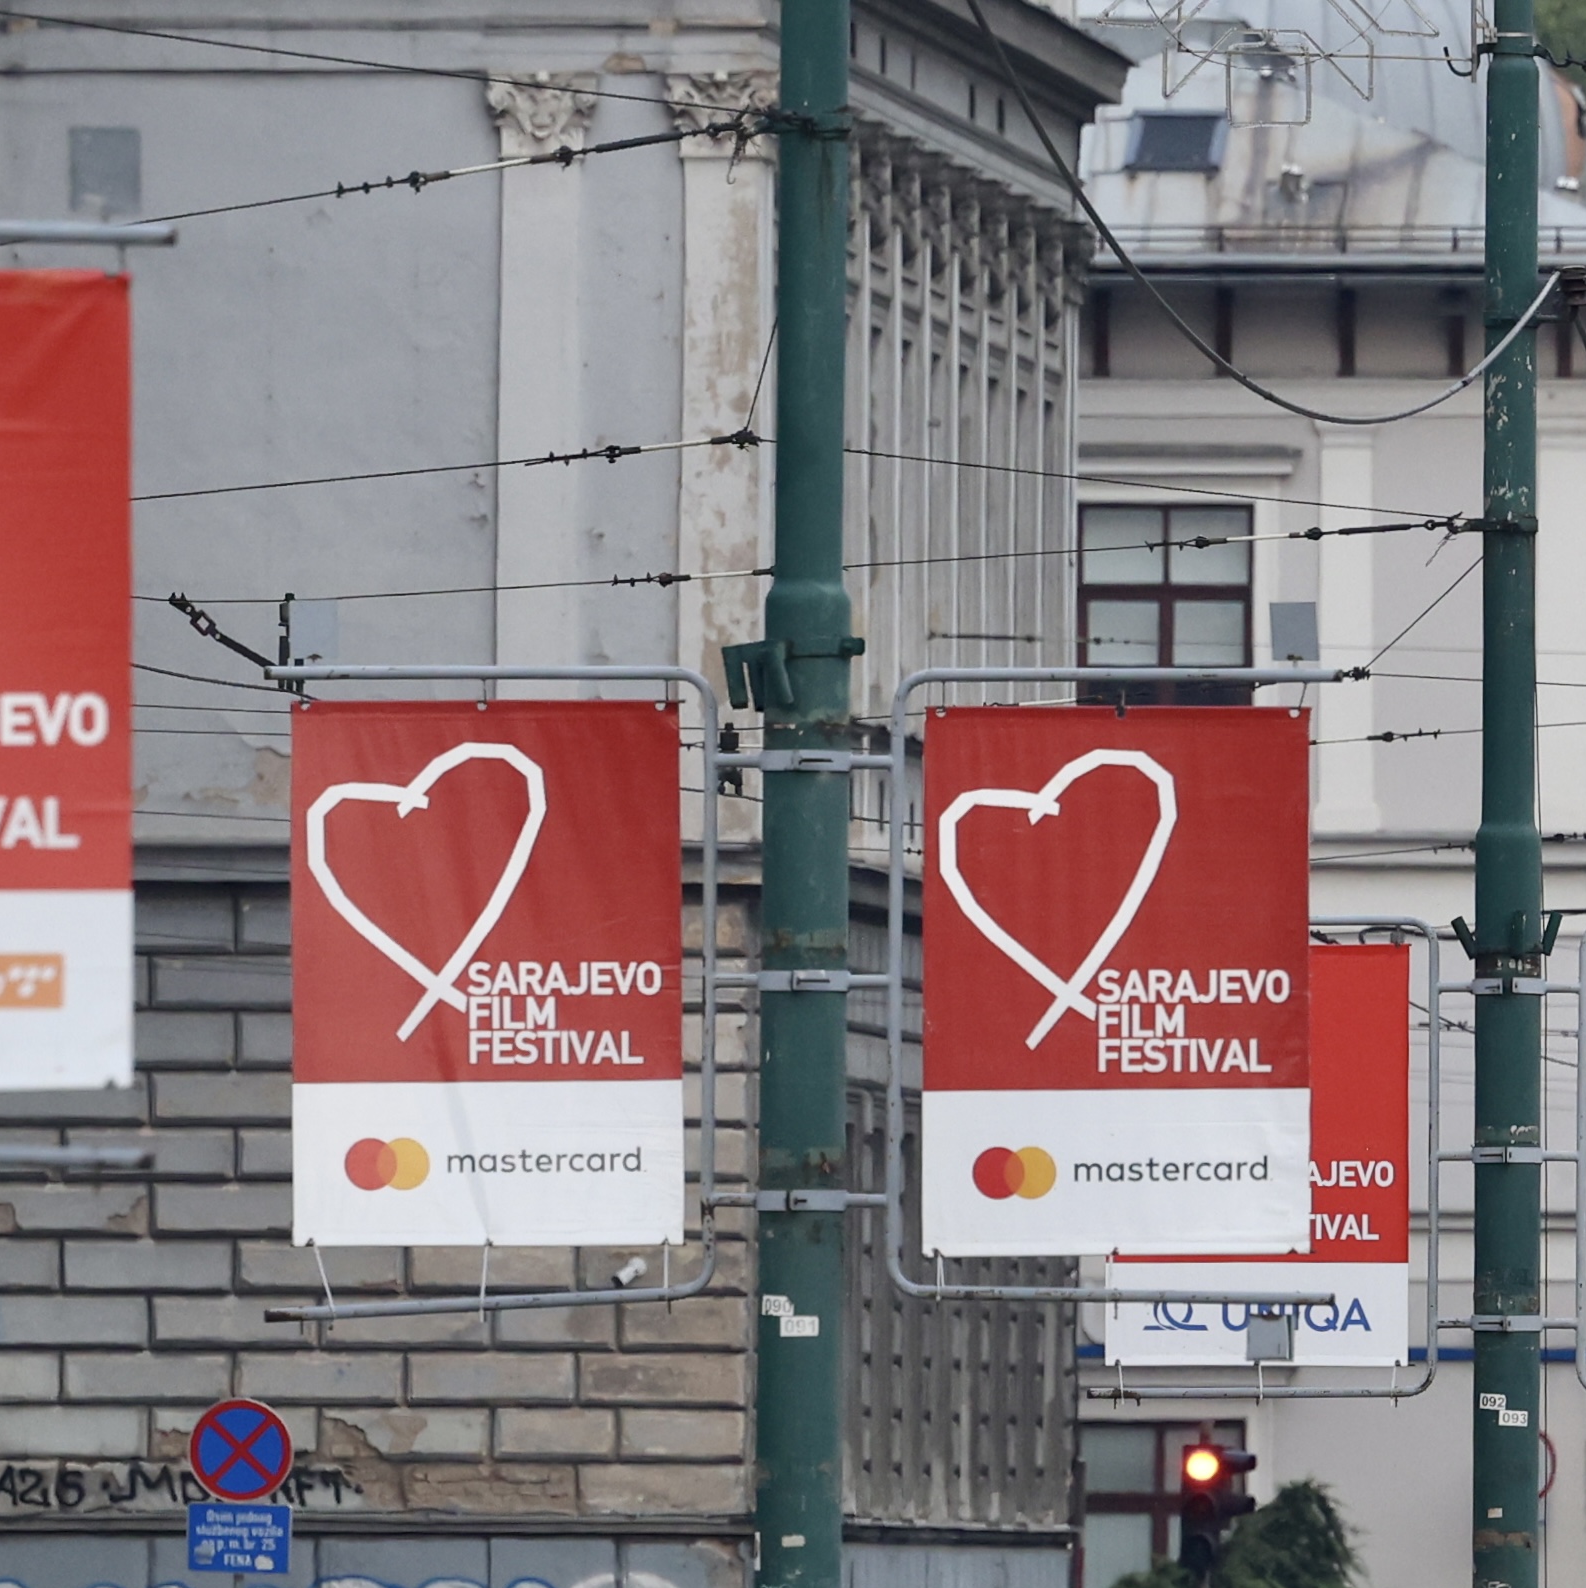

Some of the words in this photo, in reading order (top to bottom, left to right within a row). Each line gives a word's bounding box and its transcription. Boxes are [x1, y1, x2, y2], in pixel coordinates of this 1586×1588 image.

[467, 961, 662, 996] SARAJEVO
[1096, 969, 1290, 1004] SARAJEVO
[468, 996, 556, 1030] FILM
[1098, 1004, 1185, 1038] FILM
[468, 1030, 644, 1065] FESTIVAL
[1098, 1038, 1272, 1073] FESTIVAL
[447, 1147, 642, 1174] mastercard
[1074, 1155, 1269, 1182] mastercard
[1309, 1160, 1394, 1188] AJEVO
[1481, 1395, 1505, 1409] 092
[1502, 1413, 1528, 1425] 093
